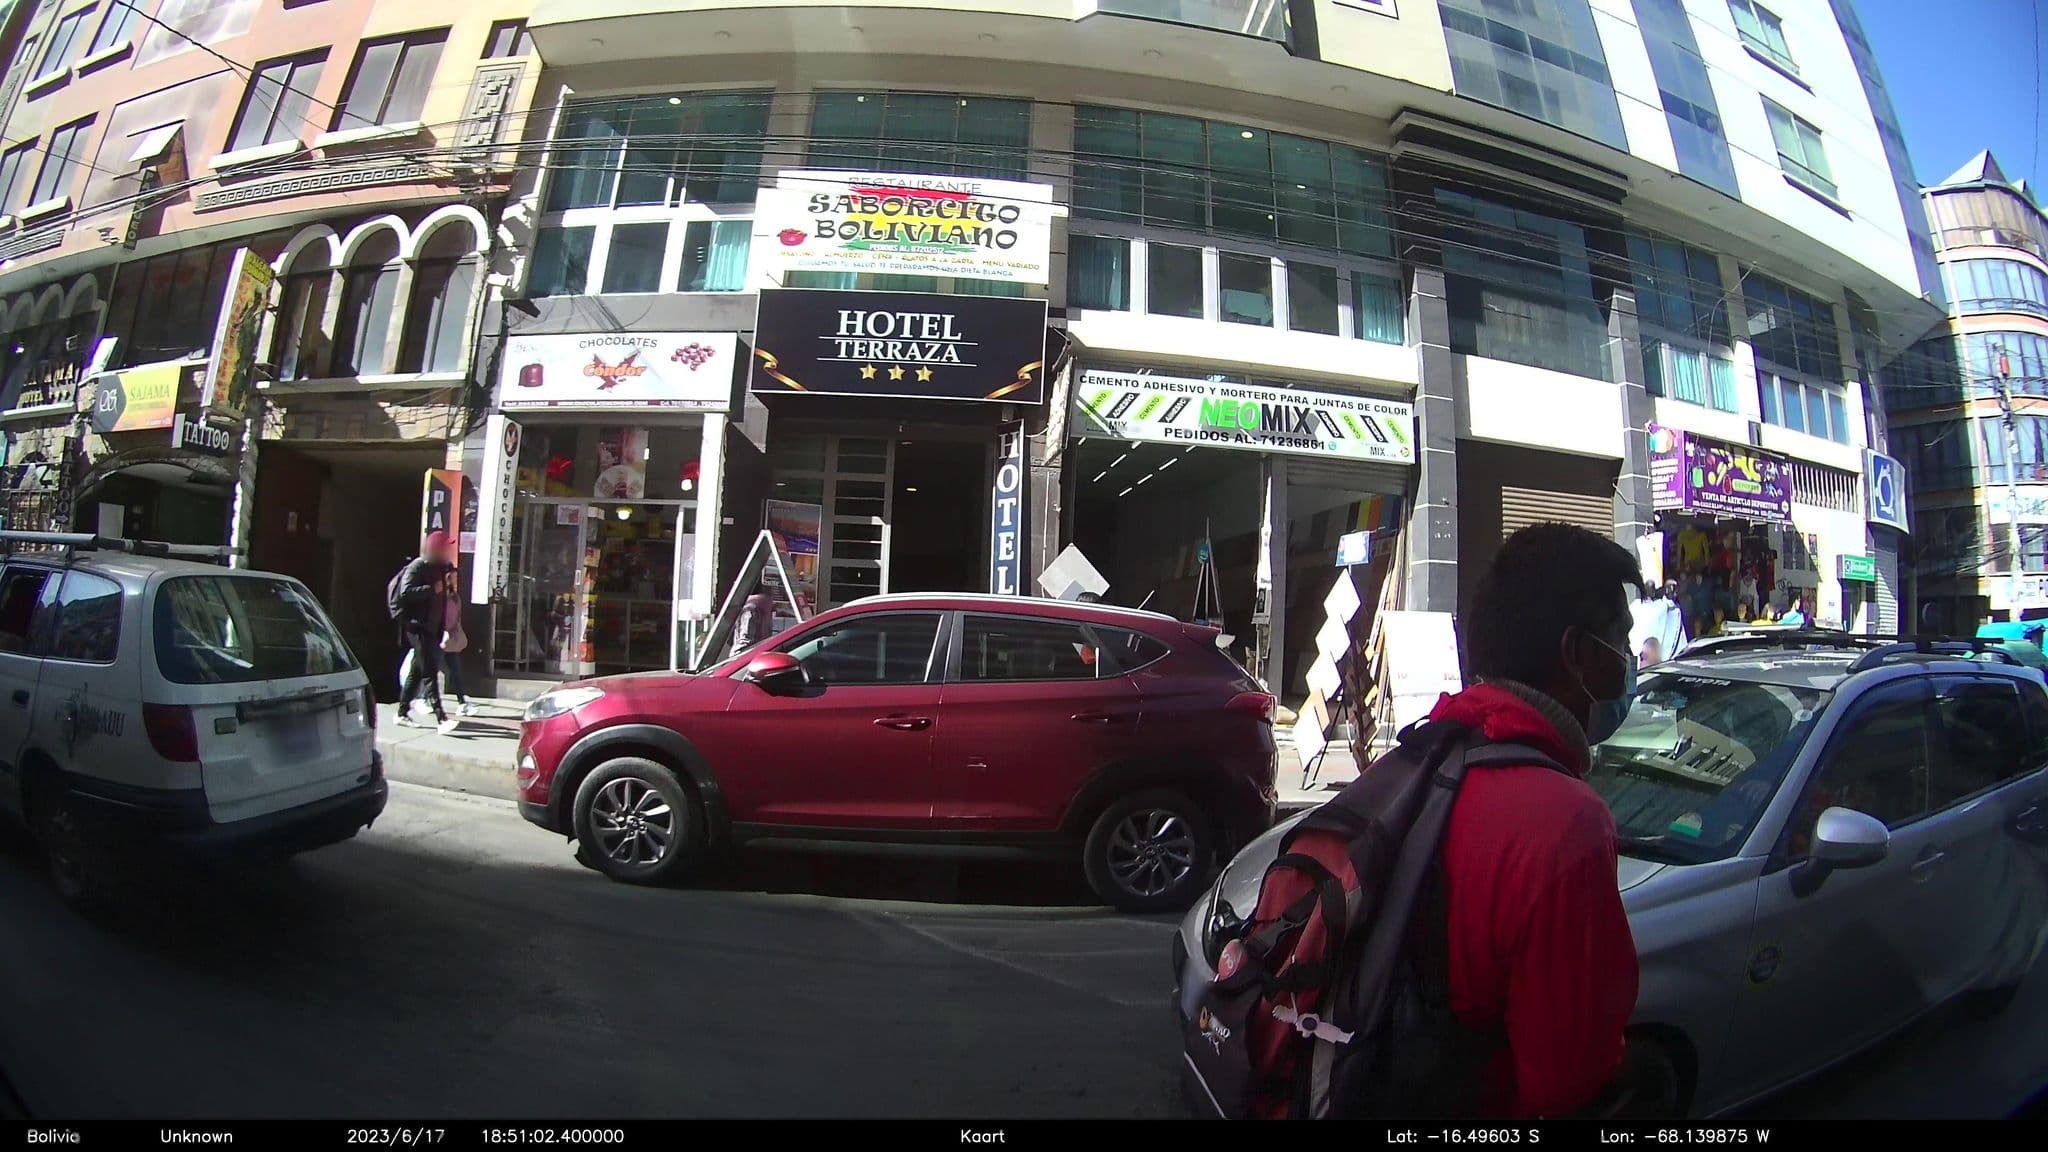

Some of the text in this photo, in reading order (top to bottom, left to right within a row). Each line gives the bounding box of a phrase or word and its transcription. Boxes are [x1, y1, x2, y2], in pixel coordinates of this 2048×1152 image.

[848, 177, 982, 194] RESTAURANTE
[807, 193, 1021, 224] SABORCITO
[814, 219, 1019, 249] BOLIVIANO
[836, 310, 962, 340] HOTEL
[579, 336, 658, 349] CHOCOLATES
[835, 339, 961, 363] TERRAZA
[1080, 375, 1408, 416] CEMENTO ADHESIVO Y MORTERO PARA JUNTAS DE COLOR
[1139, 396, 1160, 420] CEMENTO
[184, 420, 230, 451] TATTOO
[1164, 427, 1230, 442] PEDIDOS
[1234, 433, 1257, 445] AL:
[58, 438, 75, 513] TATTOO
[997, 431, 1020, 594] HOTEL
[494, 460, 512, 600] CHOCOLATES
[1677, 676, 1731, 687] TOYOTA
